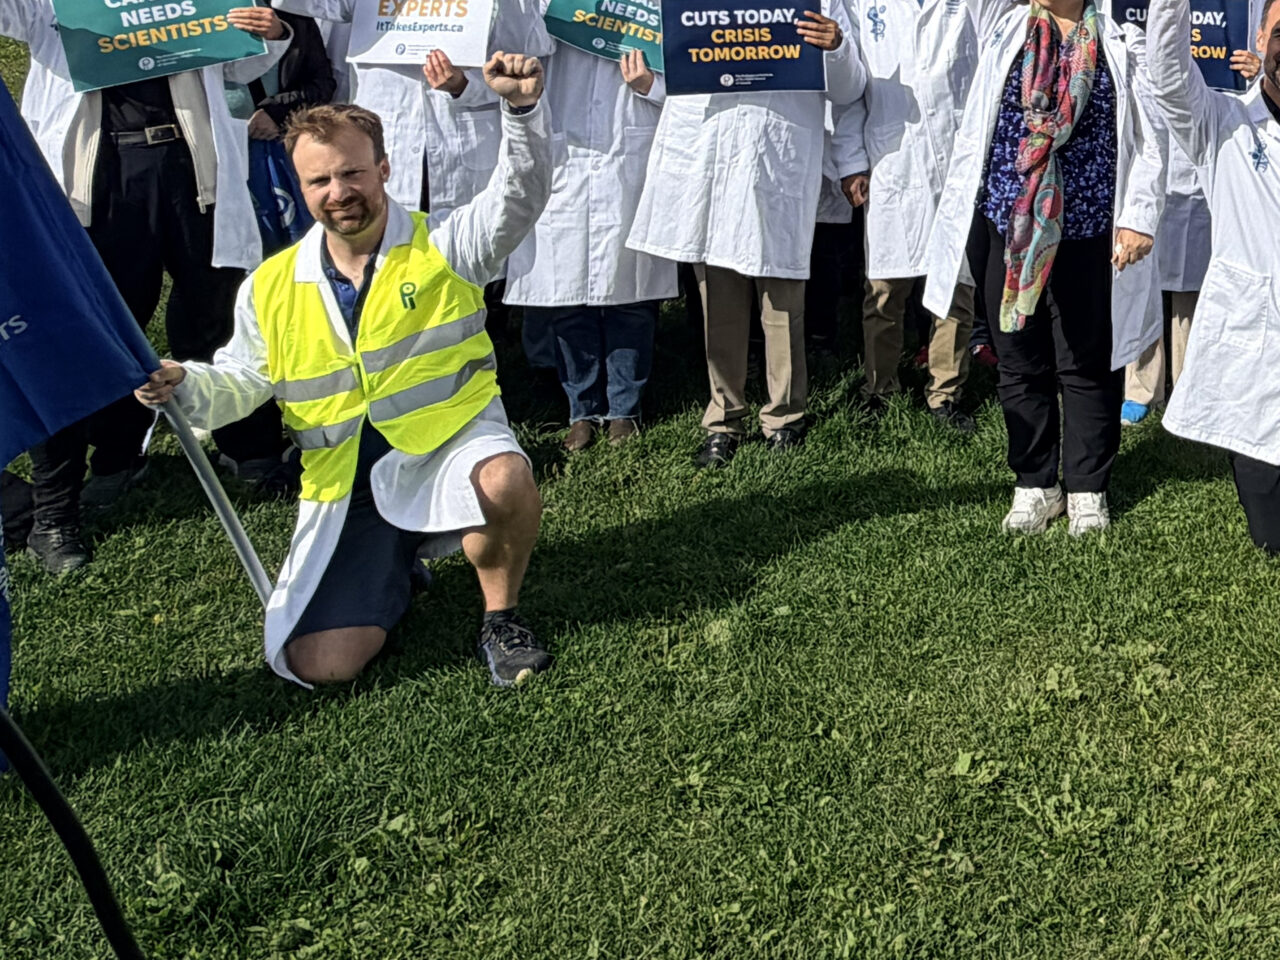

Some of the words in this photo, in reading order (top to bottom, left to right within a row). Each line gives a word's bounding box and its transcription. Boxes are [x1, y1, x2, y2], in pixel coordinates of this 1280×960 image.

[120, 0, 197, 27] NEEDS
[681, 10, 731, 27] CUTS
[733, 8, 799, 26] TODAY,
[1189, 11, 1227, 28] DAY,
[97, 15, 228, 53] SCIENTISTS
[572, 9, 663, 45] SCIENTIST
[711, 27, 772, 43] CRISIS
[688, 44, 801, 63] TOMORROW
